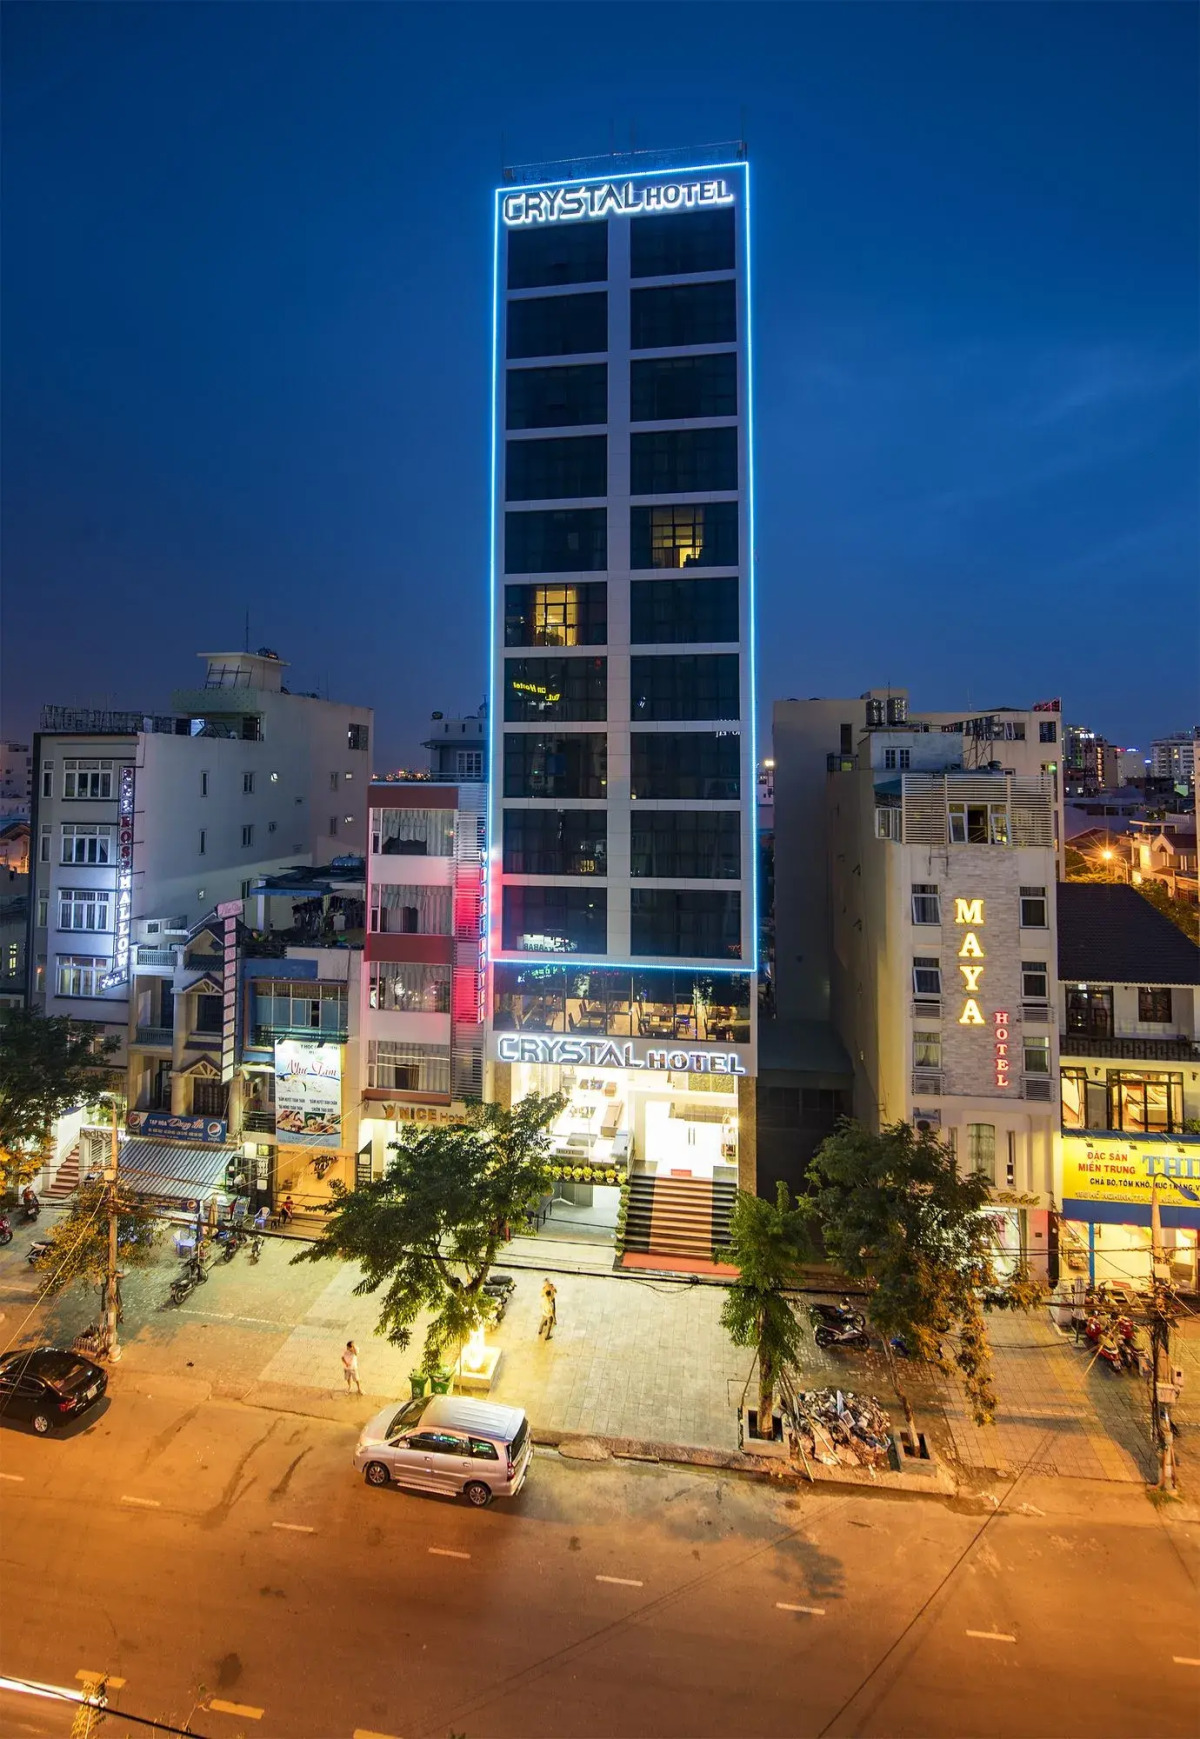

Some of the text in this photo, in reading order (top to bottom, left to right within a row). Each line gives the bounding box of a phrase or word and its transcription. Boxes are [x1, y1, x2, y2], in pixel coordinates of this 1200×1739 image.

[503, 180, 733, 224] CRYSTAL HOTEL
[955, 898, 985, 1024] MAYA
[497, 1033, 746, 1074] CRYSTAL HOTEL
[995, 1012, 1009, 1086] HOTEL
[399, 1106, 437, 1121] NICE
[1104, 1165, 1136, 1175] TRUNG
